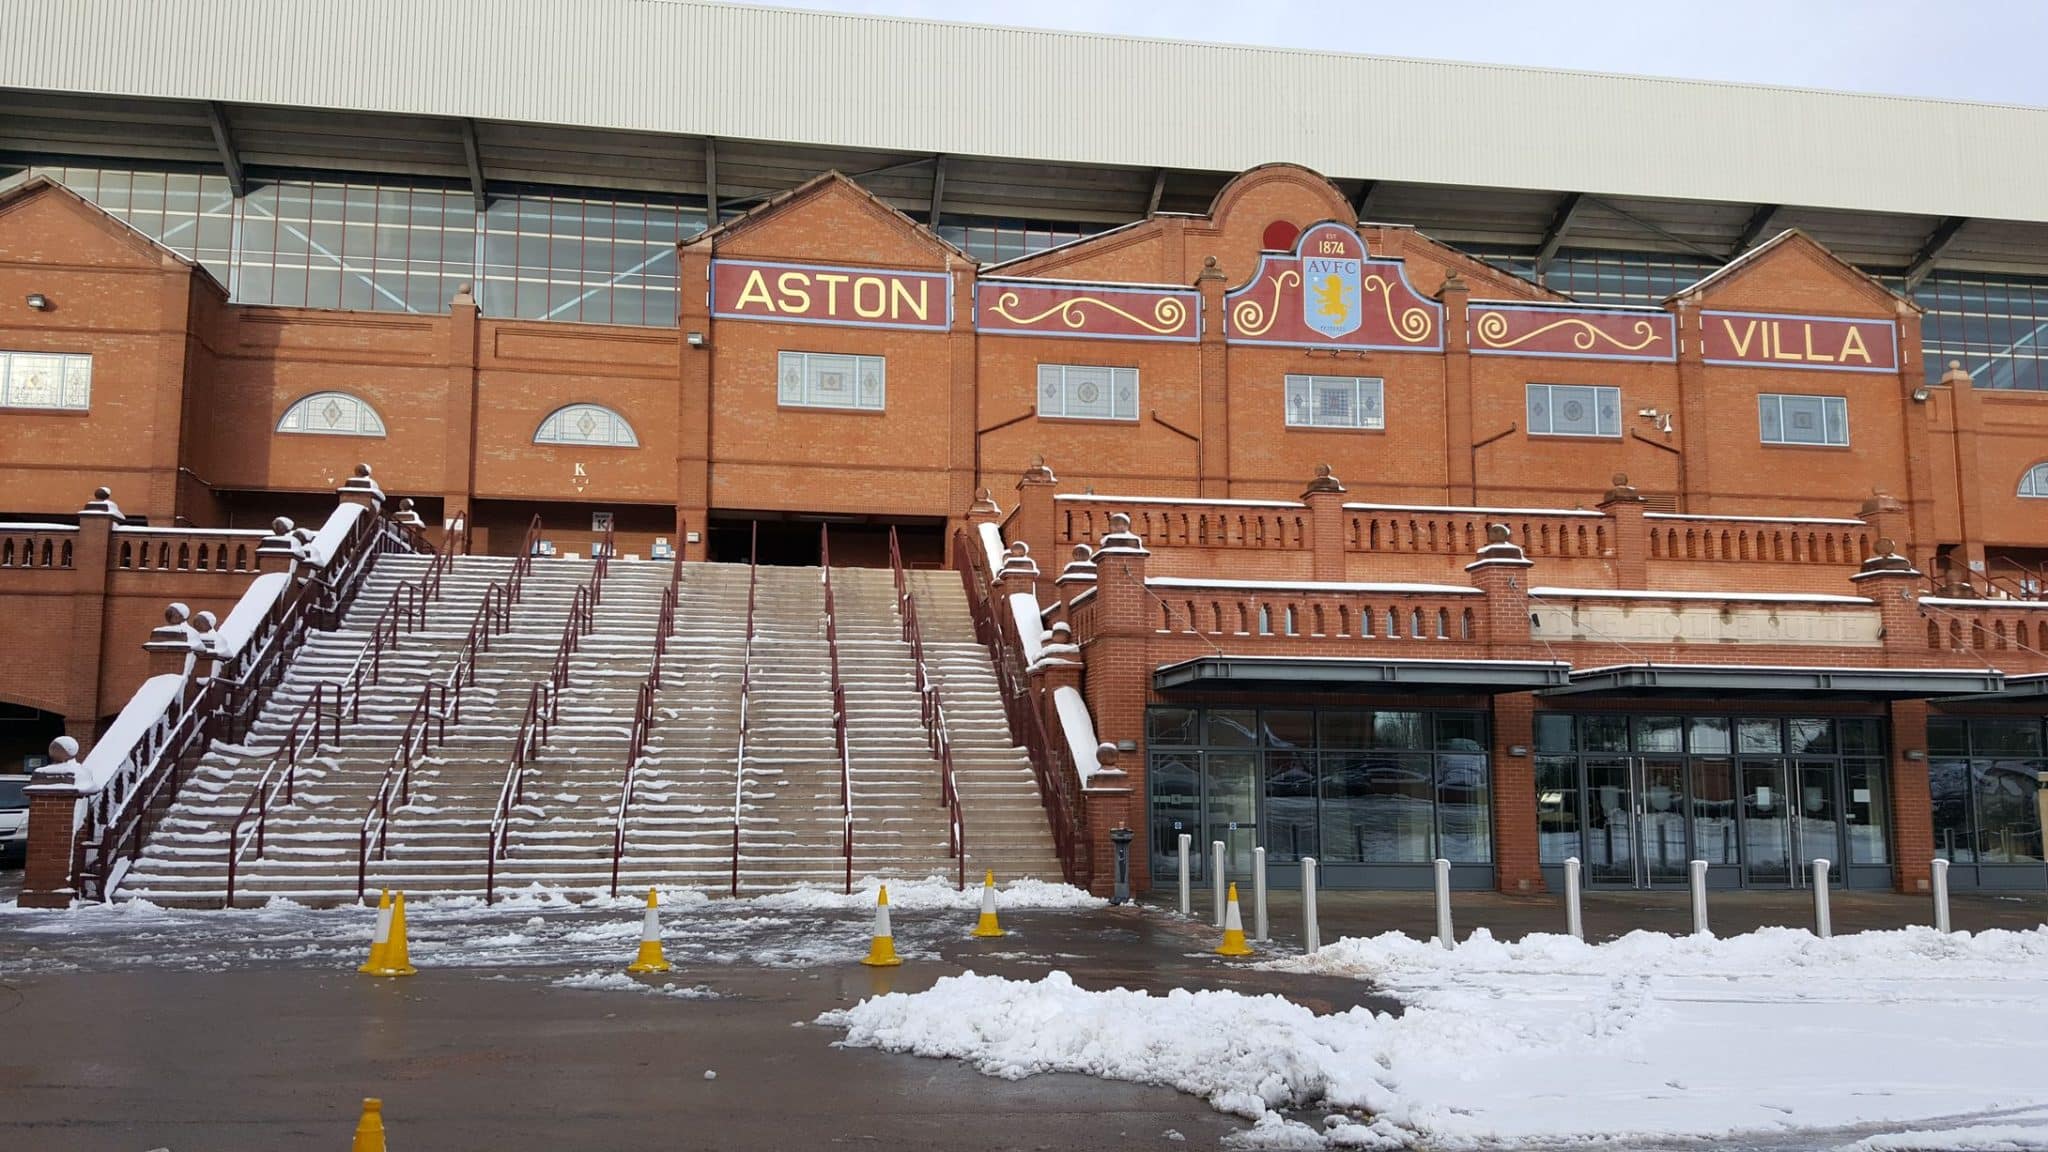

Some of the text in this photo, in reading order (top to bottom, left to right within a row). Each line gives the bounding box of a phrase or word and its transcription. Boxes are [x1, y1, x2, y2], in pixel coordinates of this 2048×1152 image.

[1319, 241, 1345, 255] 1874
[1308, 261, 1356, 275] AVFC
[734, 270, 928, 321] ASTON
[1723, 319, 1872, 364] VILLA
[574, 463, 587, 476] K
